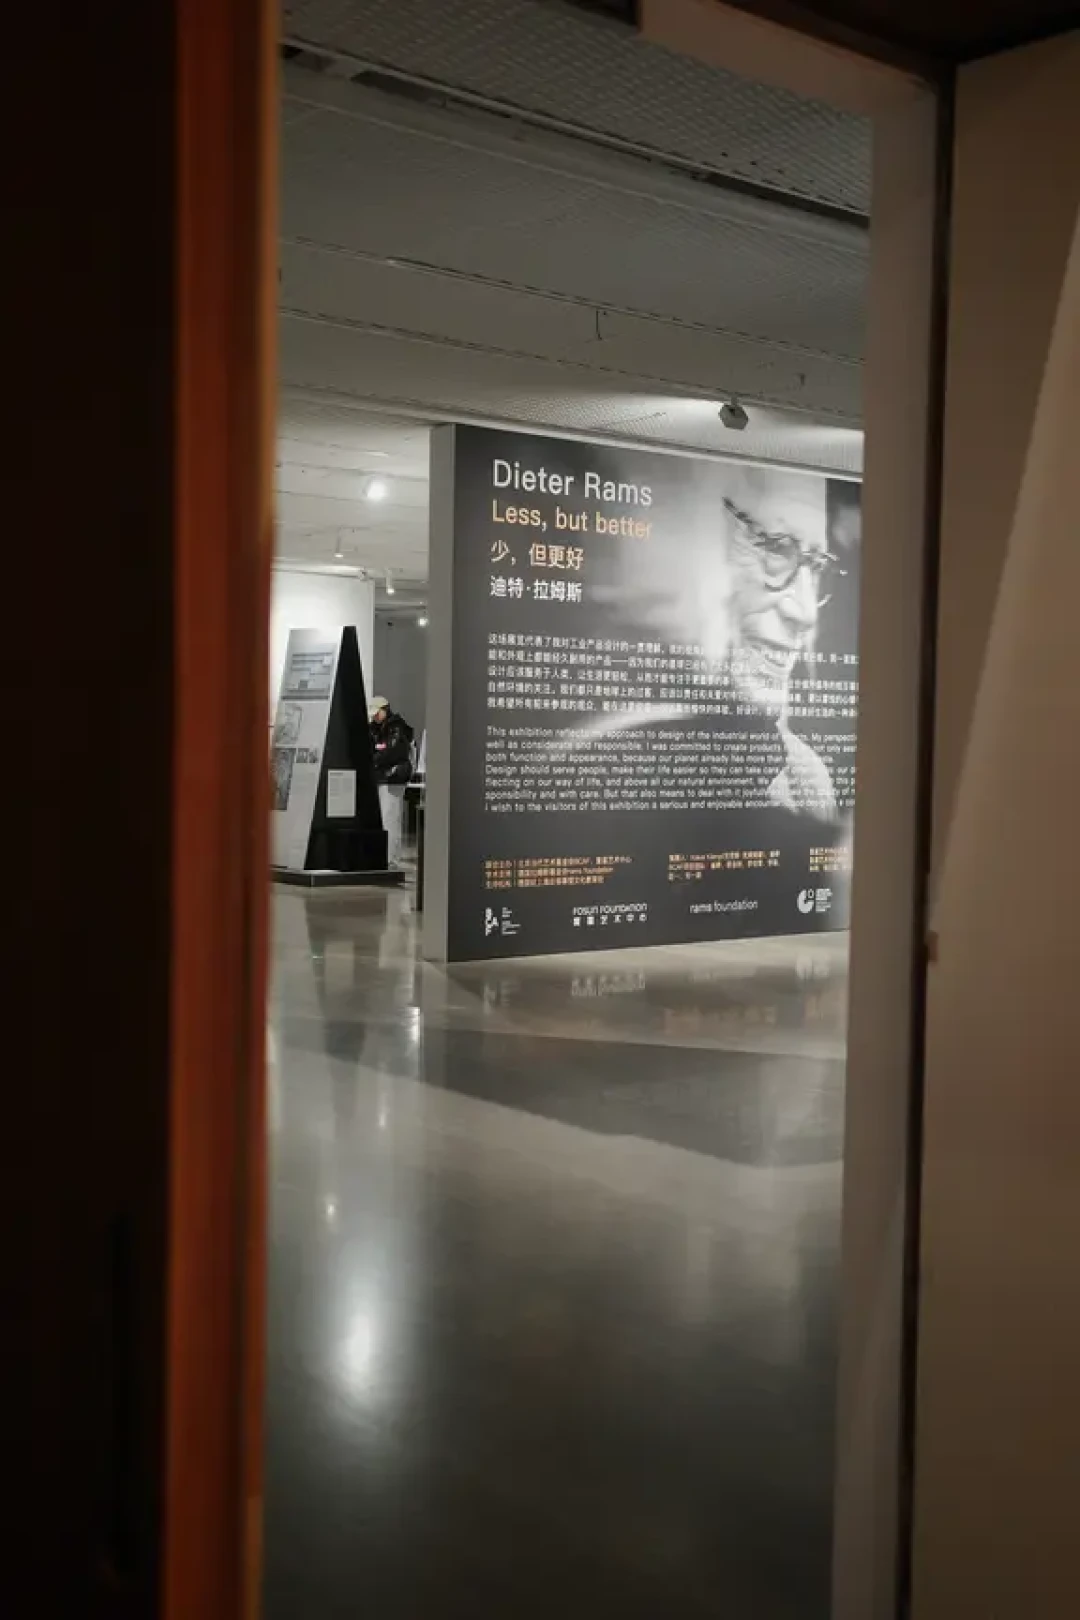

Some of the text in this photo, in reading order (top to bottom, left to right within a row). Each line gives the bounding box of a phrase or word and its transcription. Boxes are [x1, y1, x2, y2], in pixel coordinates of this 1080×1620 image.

[493, 459, 653, 506] Dieter Rams
[492, 499, 652, 540] Less, but better
[690, 896, 759, 914] rams foundation
